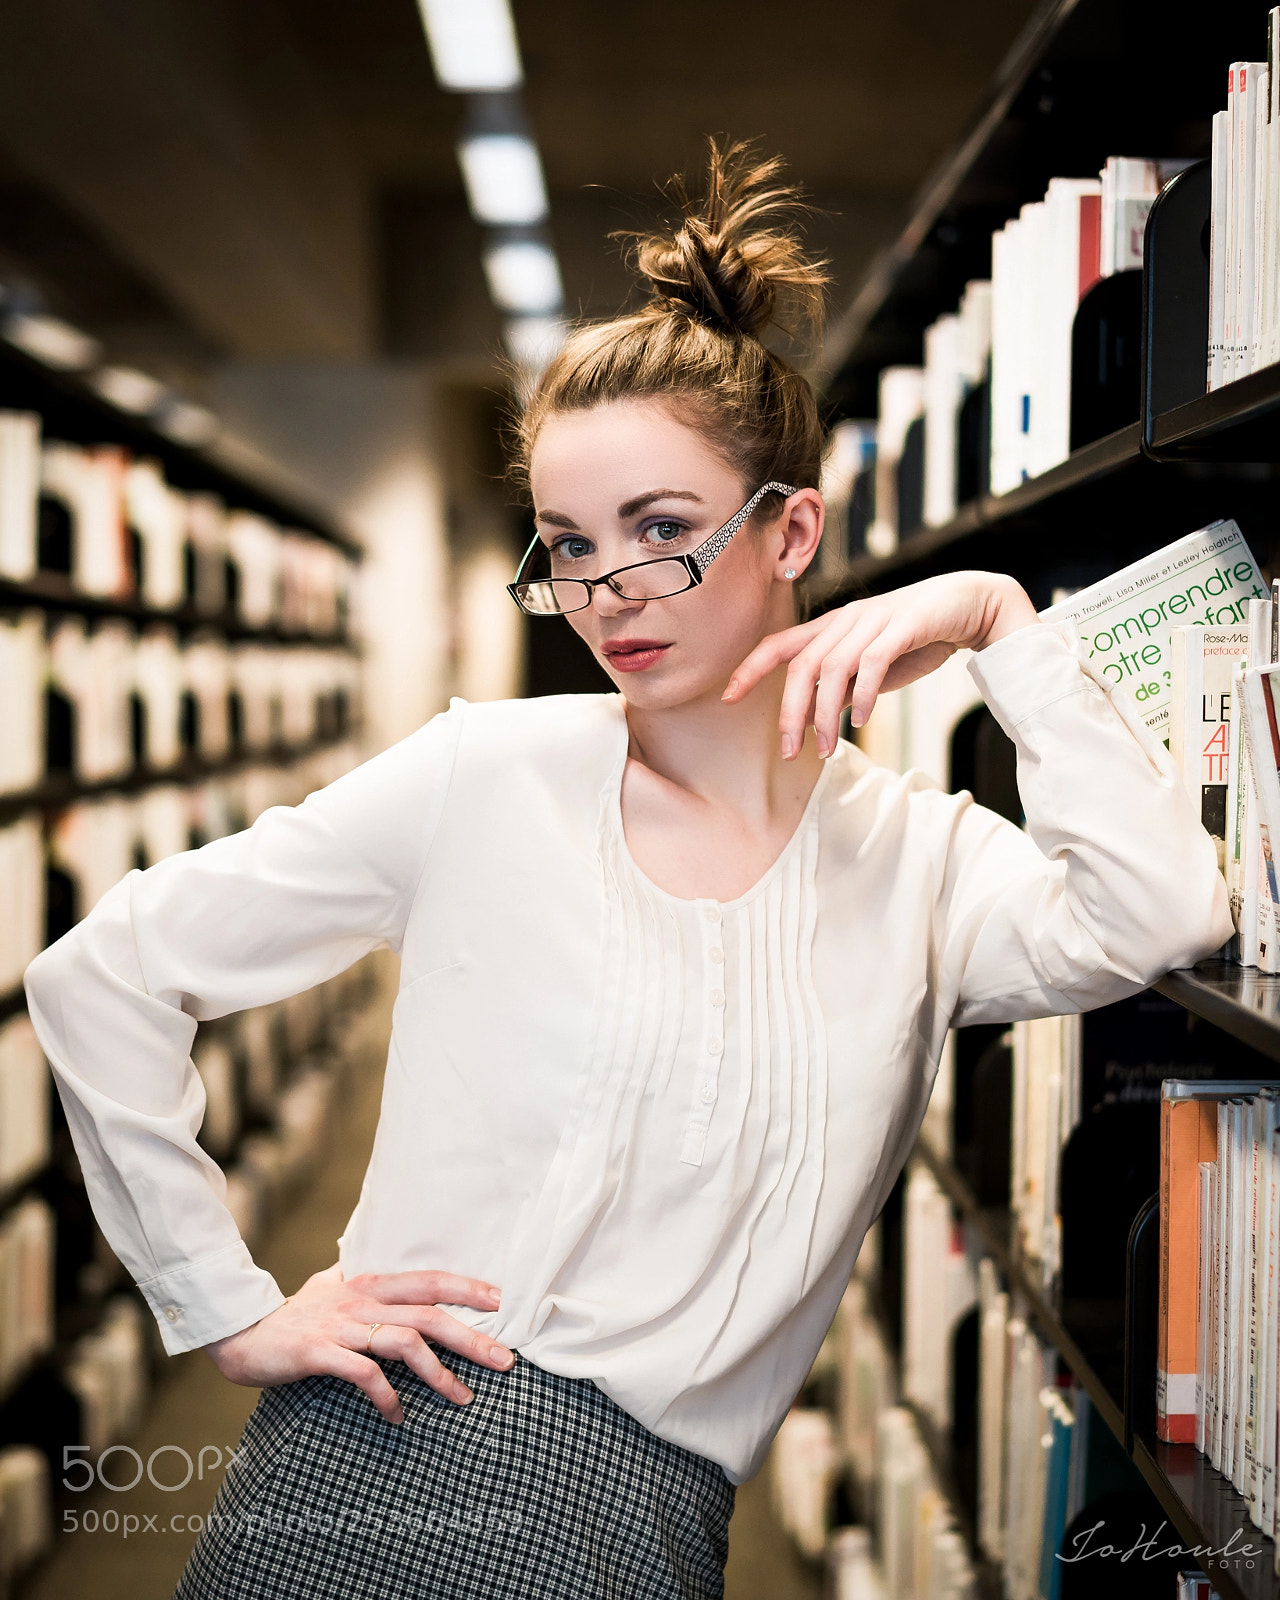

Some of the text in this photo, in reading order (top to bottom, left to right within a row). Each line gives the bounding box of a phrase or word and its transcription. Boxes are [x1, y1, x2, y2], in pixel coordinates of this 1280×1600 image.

[1116, 584, 1134, 598] Lisa
[1135, 572, 1160, 589] Miller
[1161, 565, 1172, 576] et
[1173, 552, 1200, 570] Lesley
[1202, 532, 1240, 555] Holditch
[1081, 561, 1254, 658] omprendre
[1135, 682, 1161, 701] de
